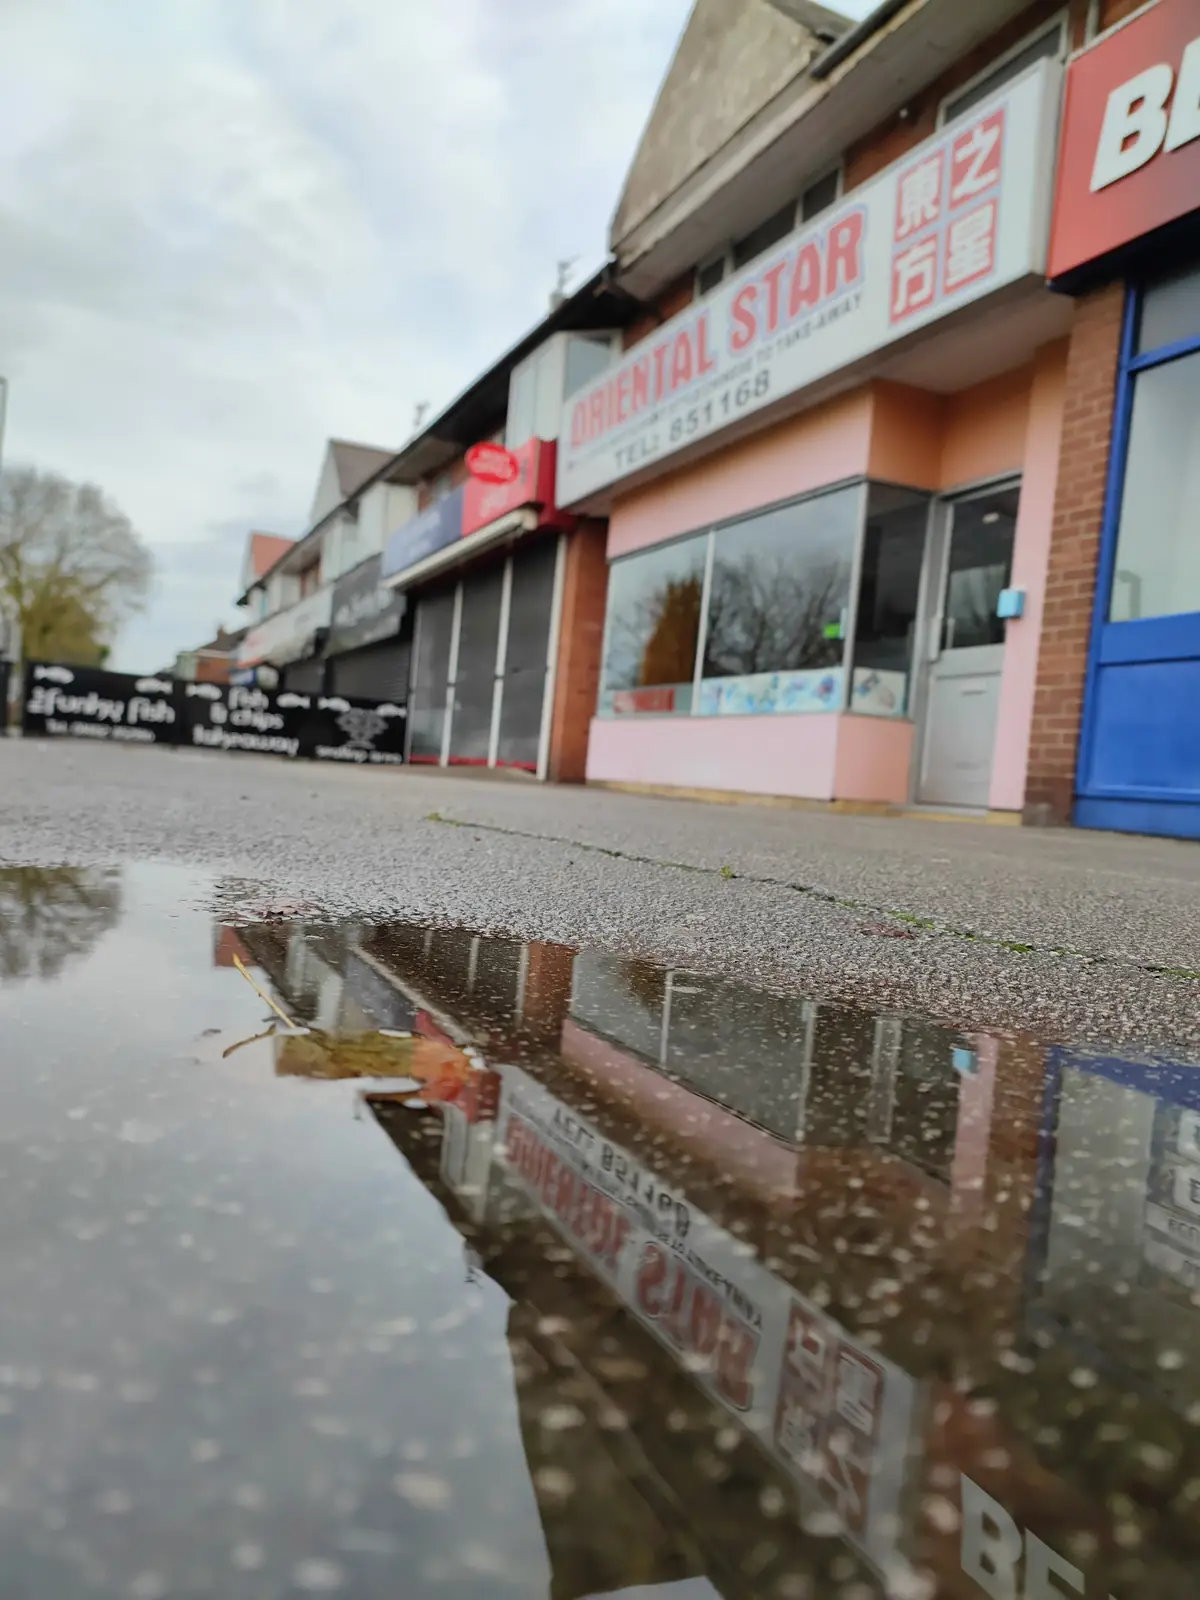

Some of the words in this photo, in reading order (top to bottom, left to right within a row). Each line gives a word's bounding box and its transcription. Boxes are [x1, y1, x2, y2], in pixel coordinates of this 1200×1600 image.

[571, 312, 714, 448] ORIENTAL
[731, 211, 863, 350] STAR
[669, 368, 770, 443] 851168
